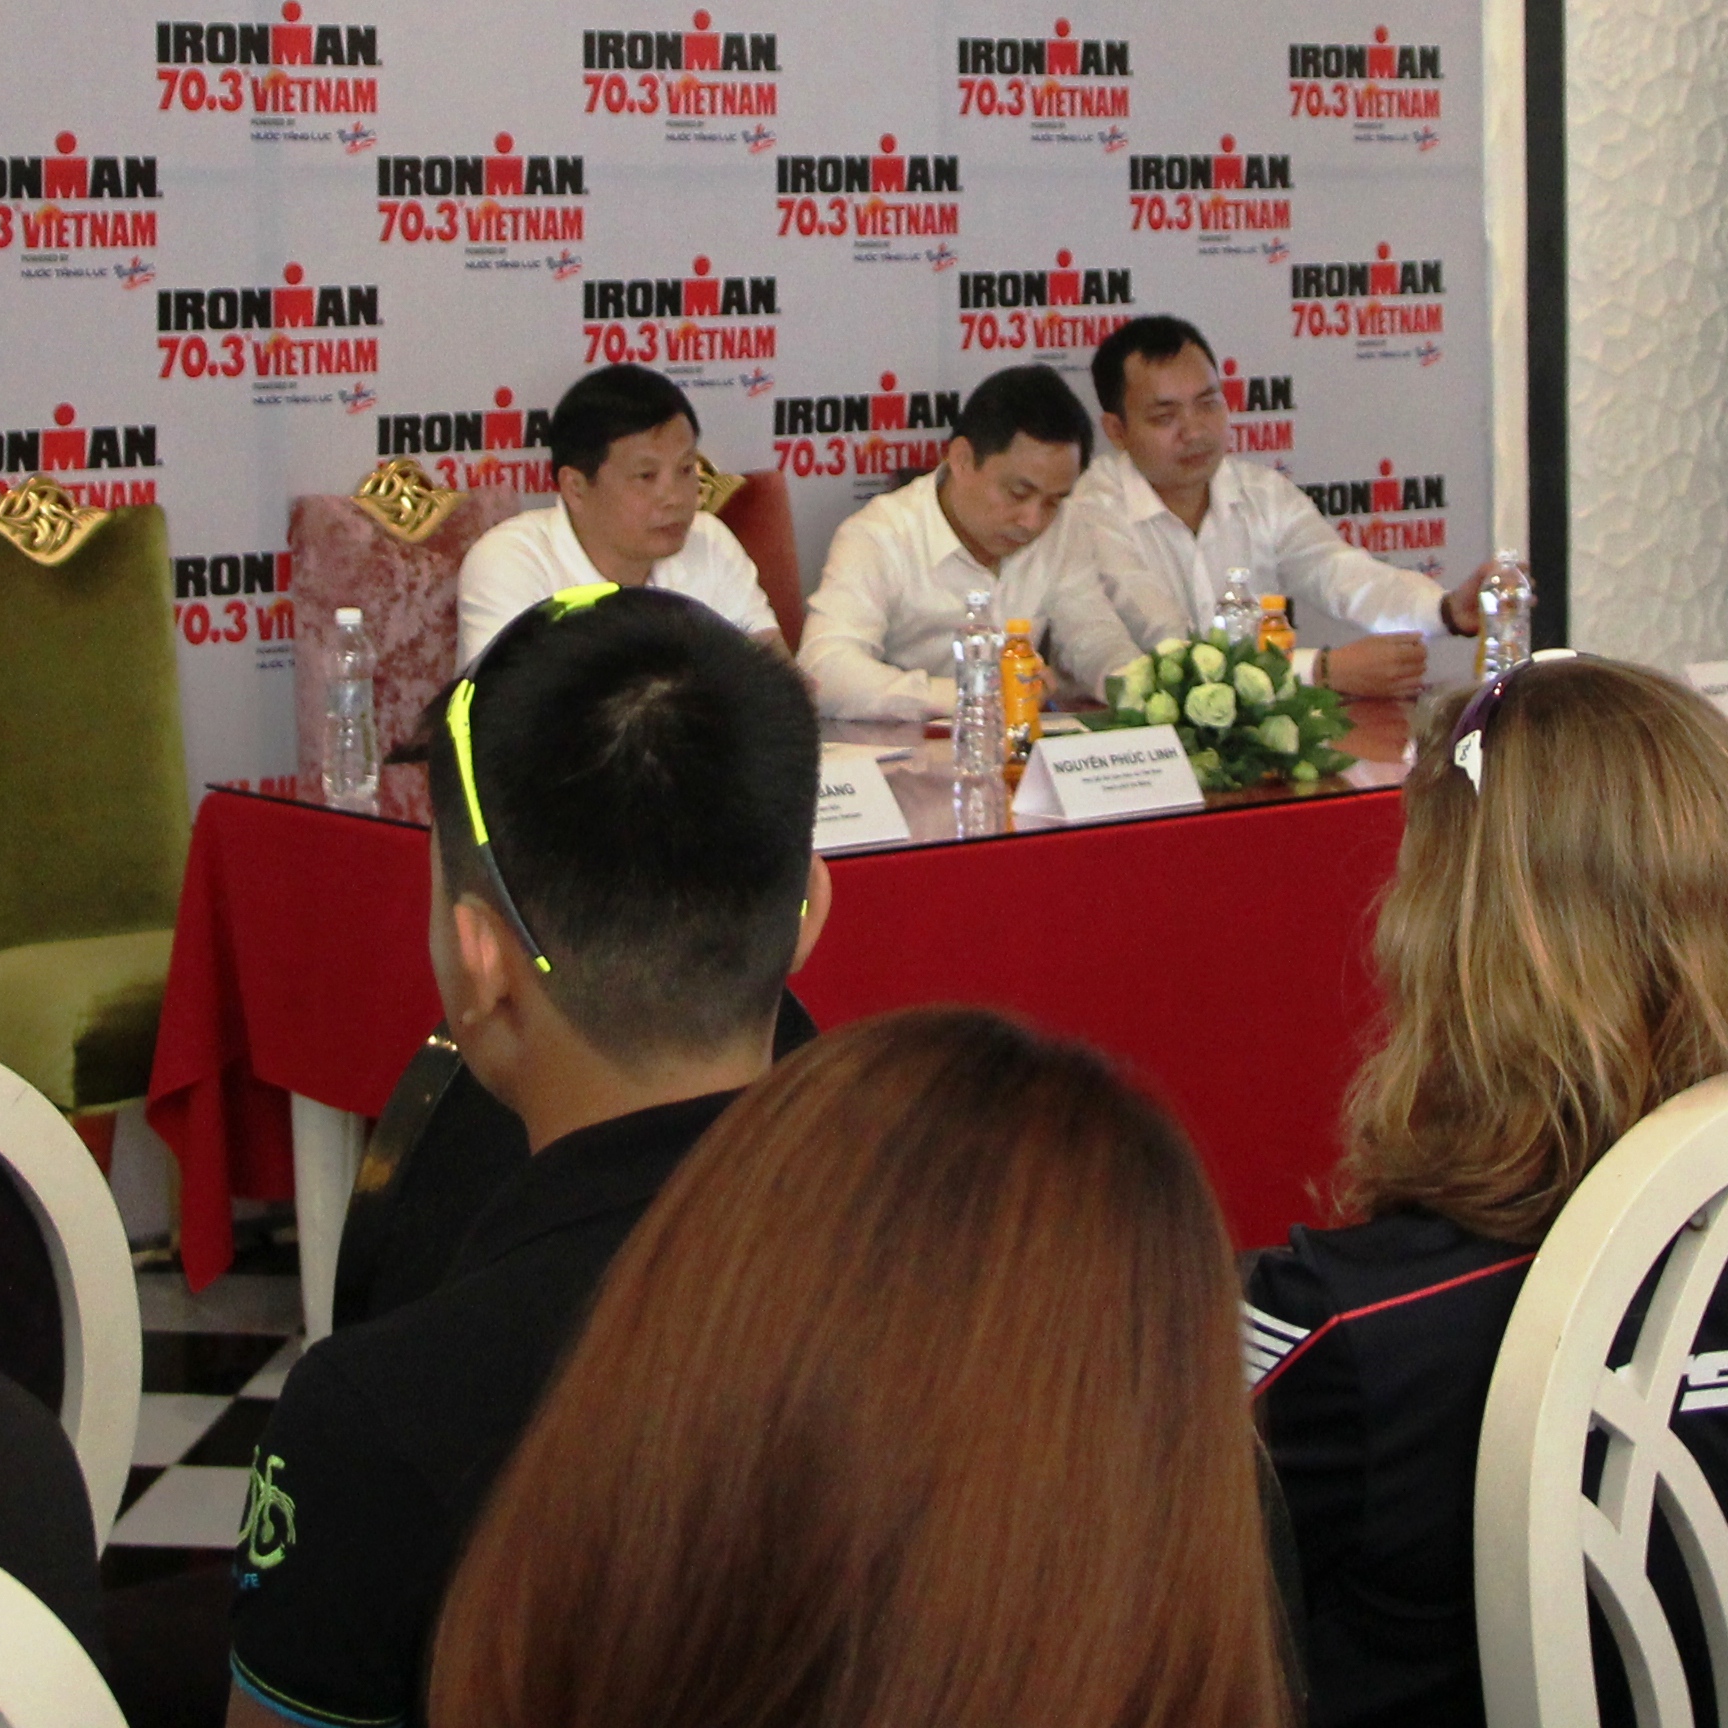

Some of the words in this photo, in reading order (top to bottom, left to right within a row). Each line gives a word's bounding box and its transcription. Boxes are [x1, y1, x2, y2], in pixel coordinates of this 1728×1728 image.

[157, 20, 378, 65] IRONMAN
[583, 29, 777, 71] IRONMAN
[958, 36, 1129, 76] IRONMAN
[1289, 43, 1442, 79] IRONMAN
[157, 68, 243, 113] 70.3
[251, 73, 378, 113] VIETNAM
[583, 74, 660, 114] 70.3
[666, 81, 777, 115] VIETNAM
[958, 78, 1028, 118] 70.3
[1032, 82, 1129, 119] VIETNAM
[1289, 81, 1349, 119] 70.3
[1355, 85, 1441, 119] VIETNAM
[377, 155, 584, 197] IRONMAN
[777, 154, 959, 194] IRONMAN
[1130, 154, 1291, 191] IRONMAN
[22, 209, 157, 249] VIETNAM
[377, 200, 459, 243] 70.3
[467, 203, 584, 243] VIETNAM
[777, 197, 849, 237] 70.3
[854, 200, 959, 237] VIETNAM
[1130, 194, 1195, 232] 70.3
[1199, 197, 1291, 231] VIETNAM
[583, 276, 776, 319] IRONMAN
[960, 268, 1131, 309] IRONMAN
[1291, 260, 1443, 299] IRONMAN
[158, 285, 378, 331] IRONMAN
[1291, 301, 1350, 339] 70.3
[1355, 304, 1443, 338] VIETNAM
[583, 324, 658, 364] 70.3
[666, 325, 776, 361] VIETNAM
[960, 313, 1027, 350] 70.3
[158, 334, 246, 379] 70.3
[252, 337, 378, 377] VIETNAM
[378, 409, 554, 455] IRONMA
[774, 391, 960, 435] IRONMAN
[774, 437, 846, 477] 70.3
[854, 440, 950, 475] VIETNA
[1296, 474, 1445, 516] RONMAN
[174, 602, 248, 645] 0.3
